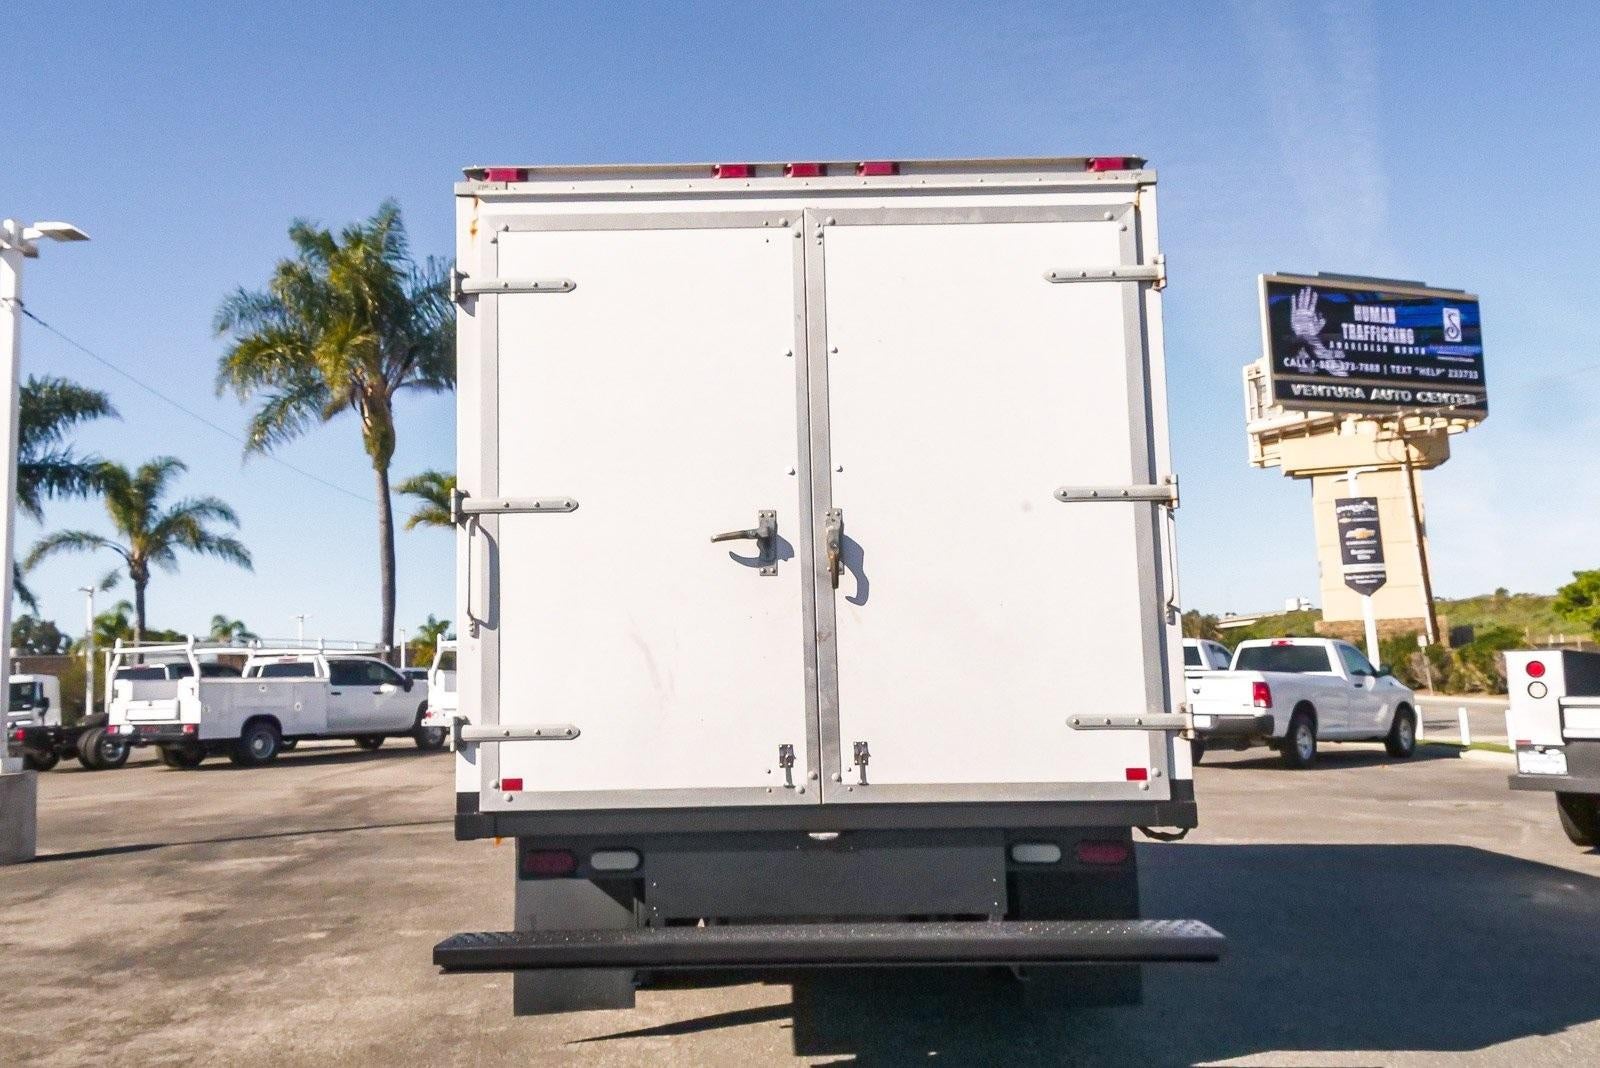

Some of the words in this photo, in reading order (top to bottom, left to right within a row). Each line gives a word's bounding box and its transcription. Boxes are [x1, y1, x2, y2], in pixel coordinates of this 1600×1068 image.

[1353, 304, 1396, 325] HUMAN
[1341, 323, 1415, 345] TRAFFICKING
[1283, 357, 1307, 368] CALL
[1390, 364, 1412, 375] TEXT
[1290, 383, 1366, 400] VENTURA
[1370, 387, 1413, 403] AUTO
[1416, 391, 1477, 405] CENTER
